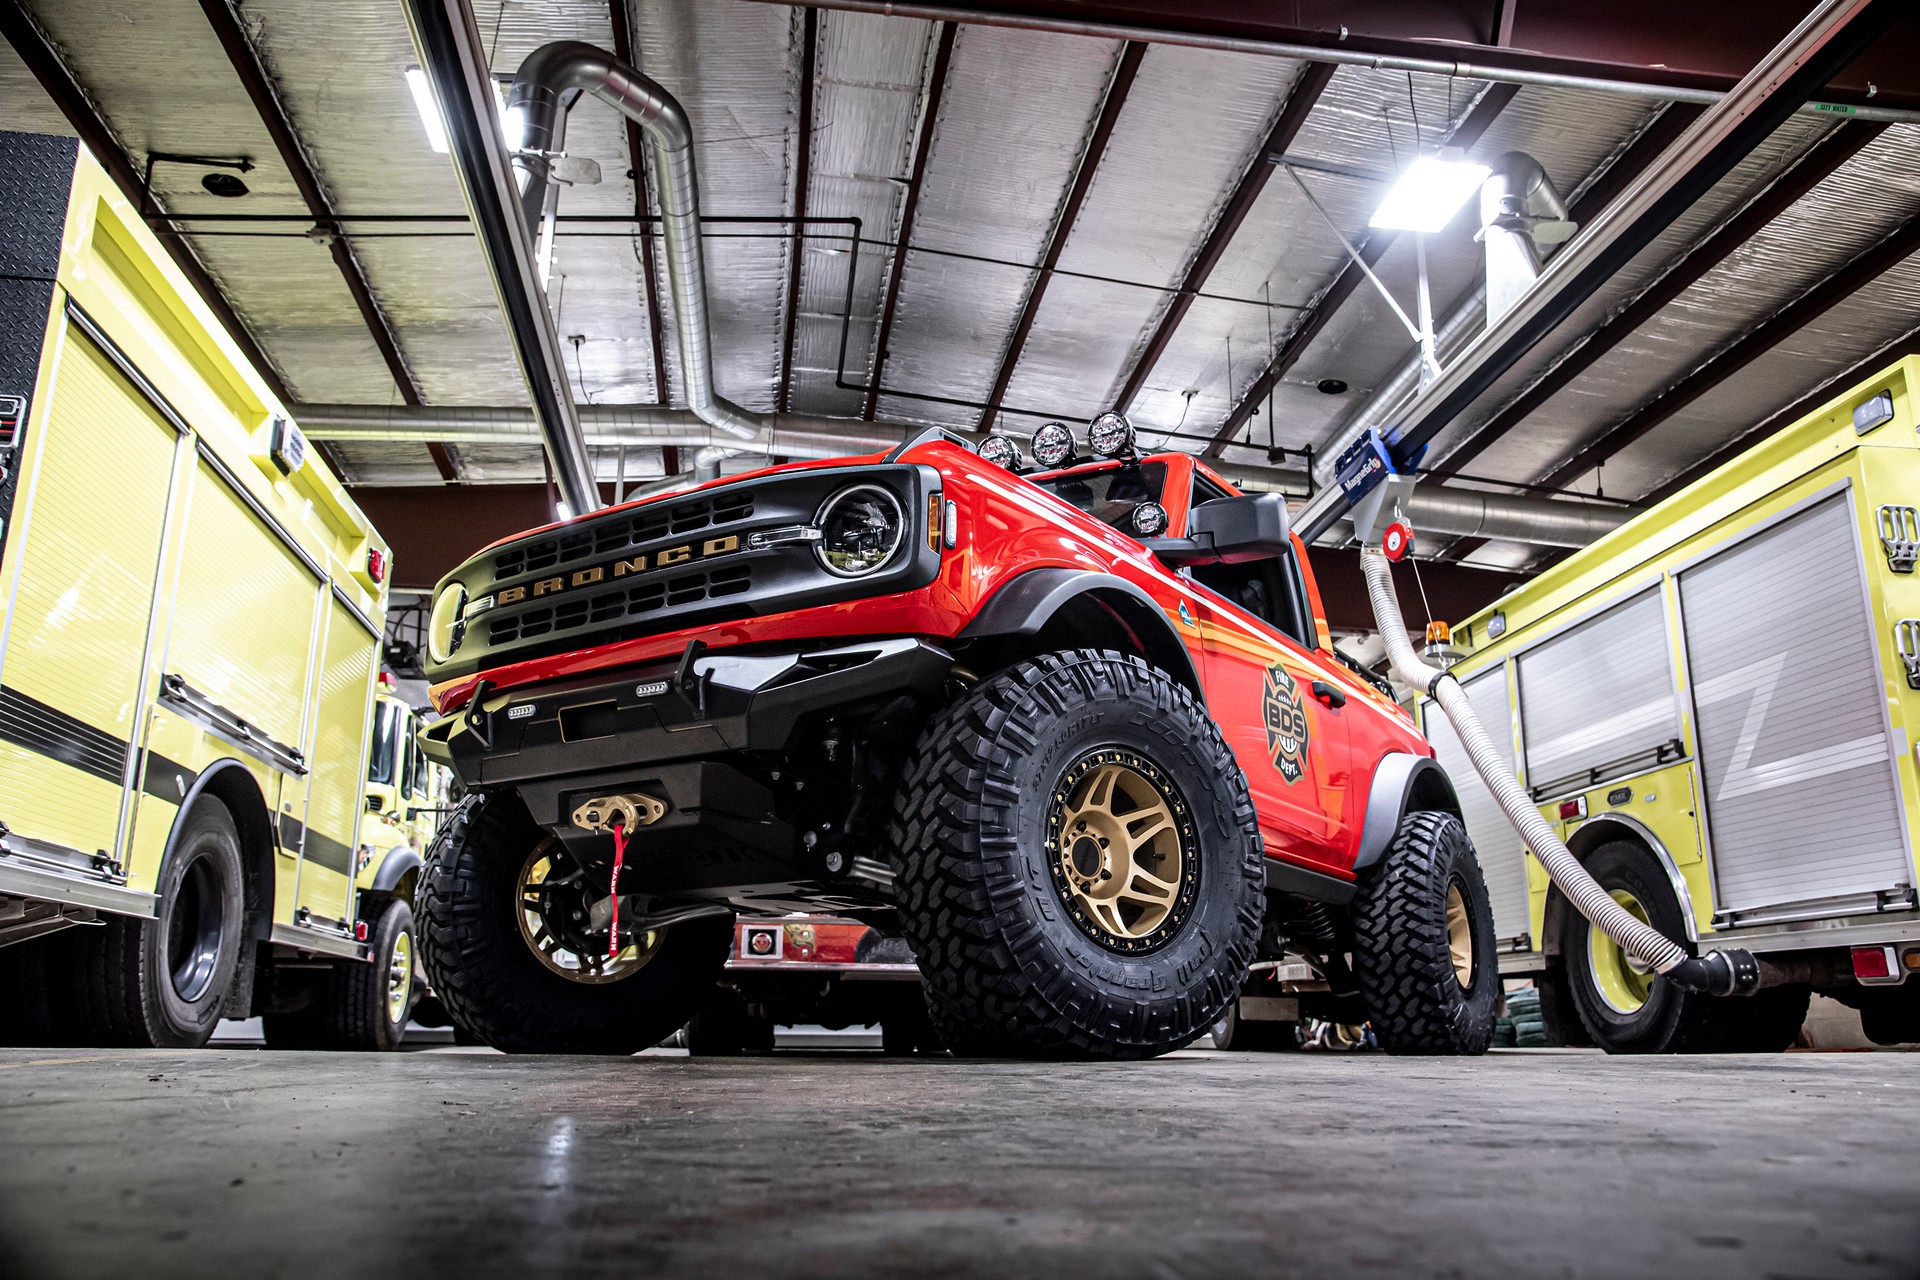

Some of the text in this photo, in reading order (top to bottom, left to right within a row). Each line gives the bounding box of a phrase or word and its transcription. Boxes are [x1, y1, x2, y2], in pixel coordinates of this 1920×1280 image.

[498, 535, 742, 606] BRONCO
[1275, 670, 1290, 689] FIRE
[1268, 700, 1305, 741] BDS
[1281, 758, 1298, 775] DEPT.
[610, 866, 619, 894] WARN
[610, 922, 618, 951] WARN
